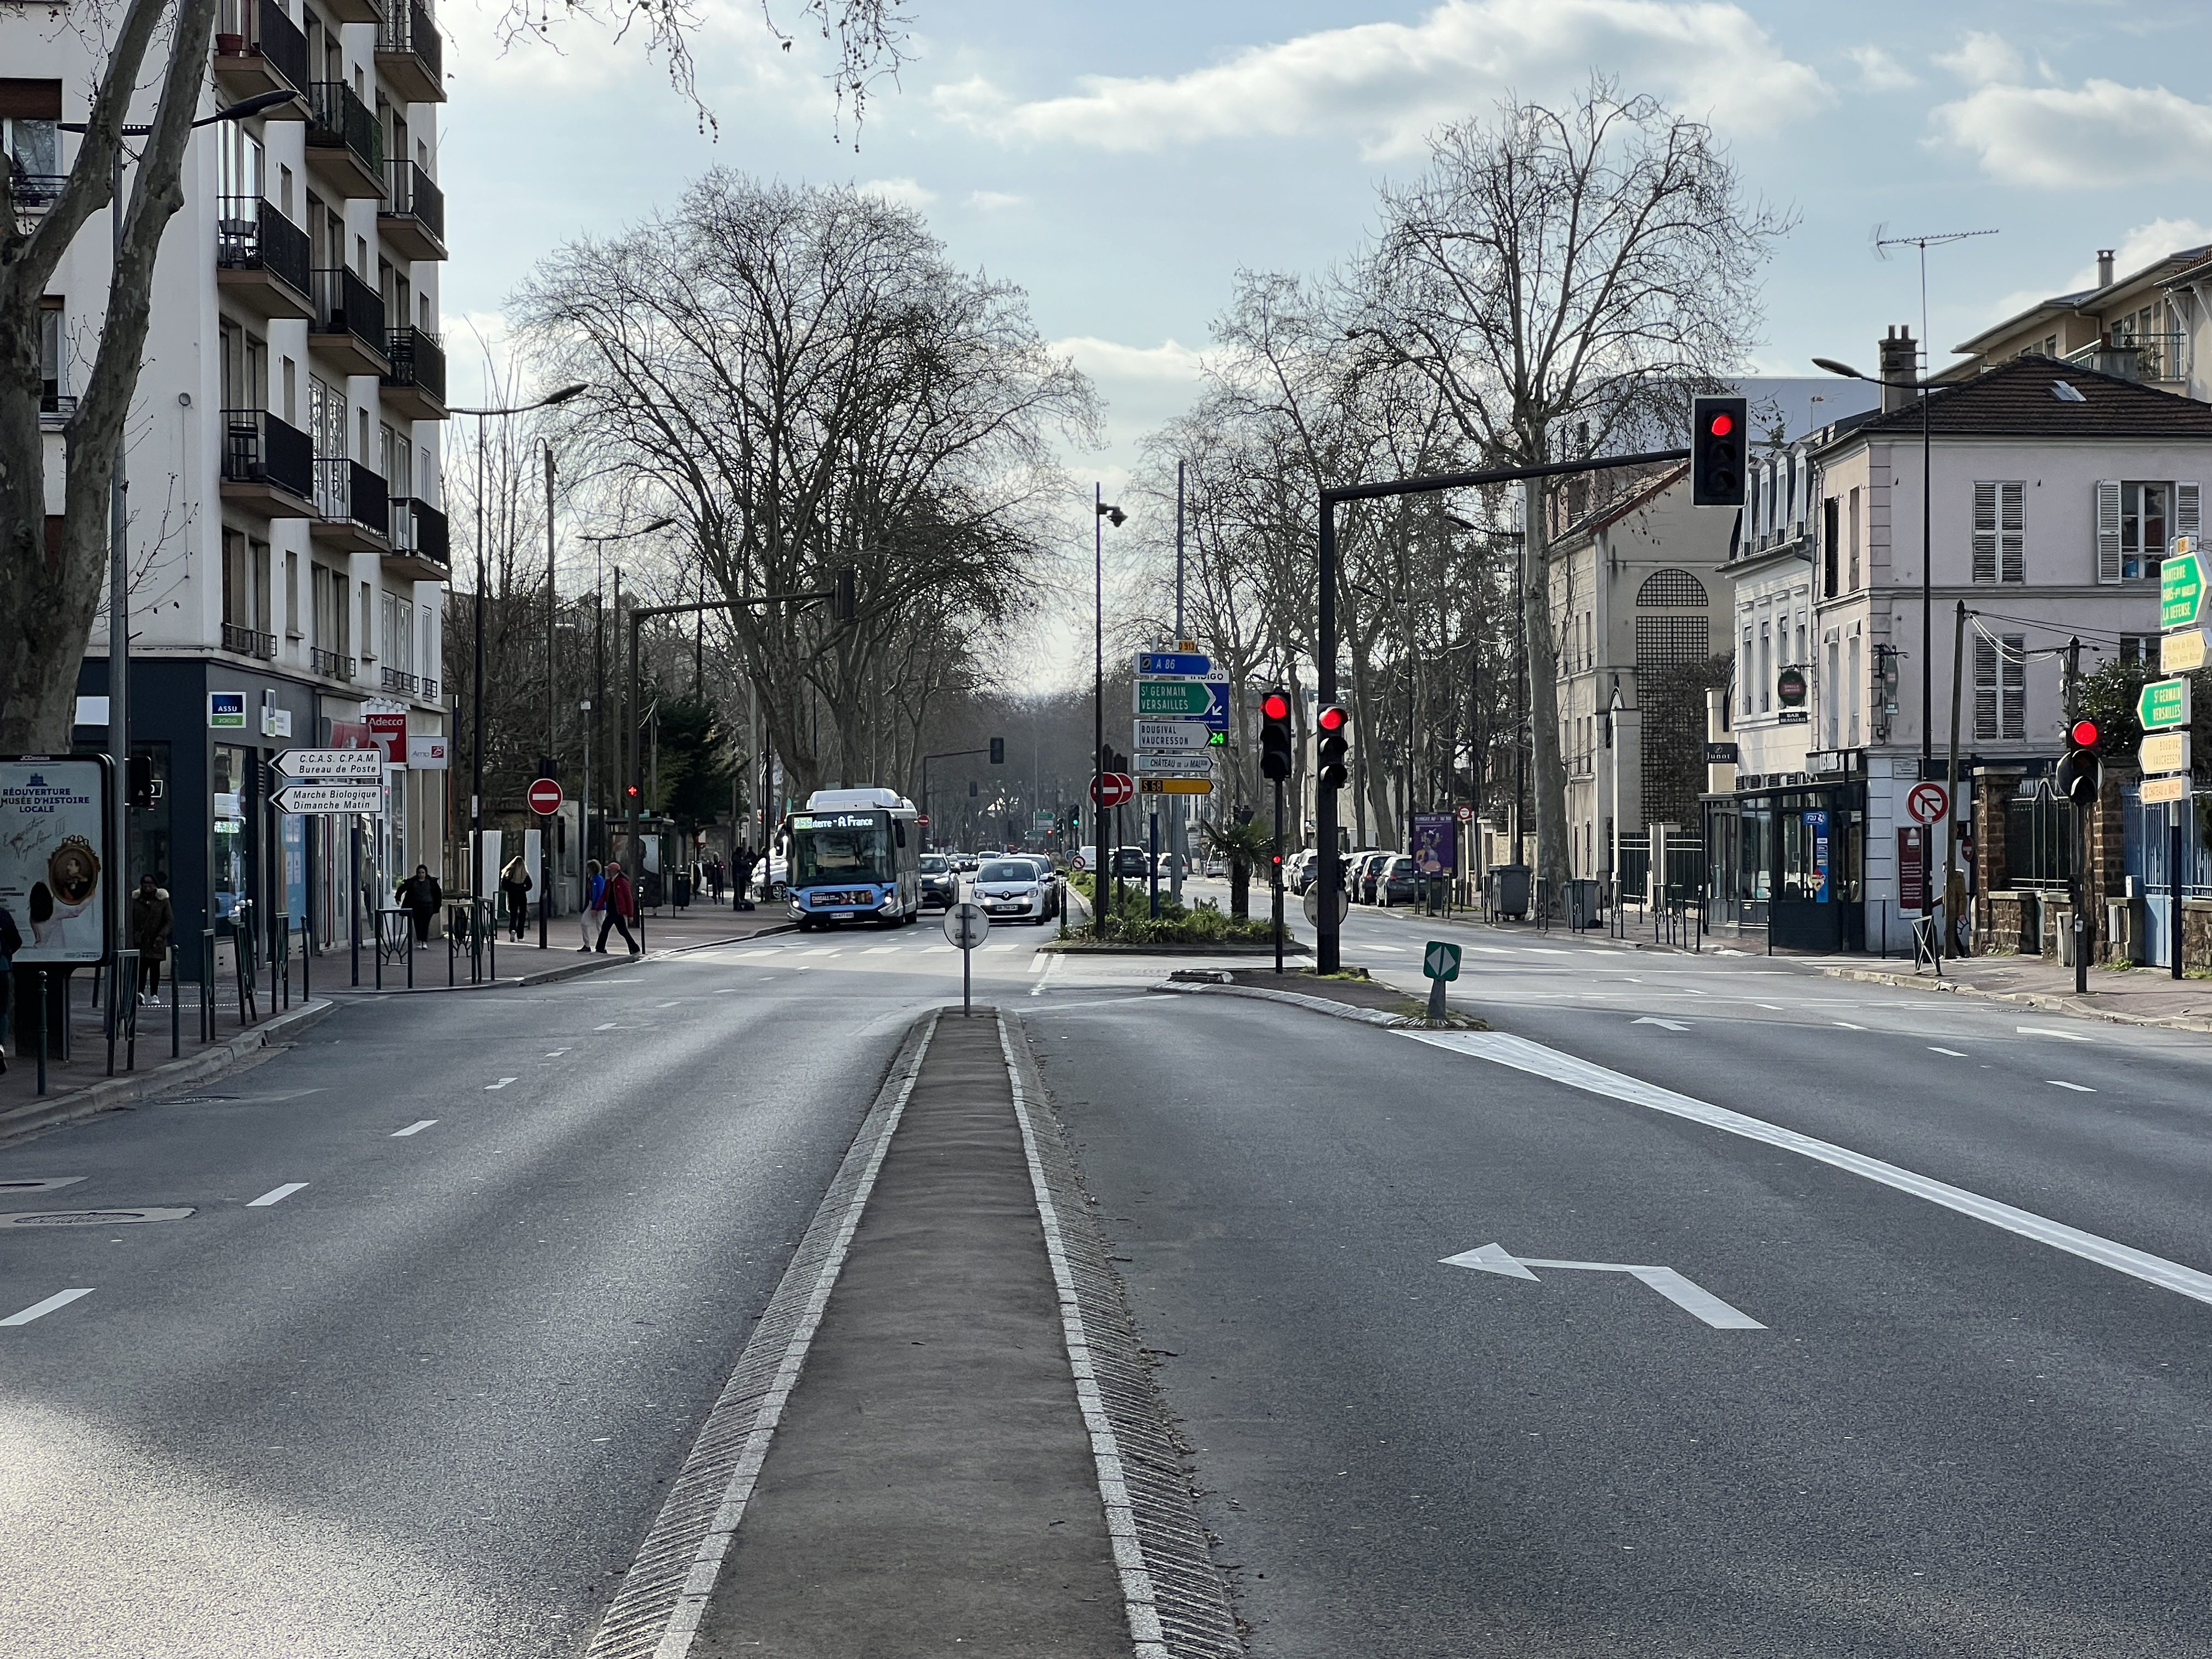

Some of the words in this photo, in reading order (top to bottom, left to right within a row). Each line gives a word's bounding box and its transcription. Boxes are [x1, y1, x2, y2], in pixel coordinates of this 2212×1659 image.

[2163, 607, 2169, 620] LA
[1156, 659, 1161, 669] A
[1165, 659, 1175, 669] 86
[1150, 686, 1186, 696] GERMAIN
[2159, 686, 2181, 702] GERMAIN
[1141, 699, 1188, 709] VERSAILLES
[2153, 704, 2181, 721] VERSAILLES
[369, 717, 404, 726] Adecco
[1141, 725, 1176, 734] BOUGIVAL
[1142, 736, 1188, 744] VAUCRESSON
[1211, 732, 1224, 744] 24
[300, 754, 335, 763] C.C.A.S.
[340, 754, 376, 763] C.P.A.M.
[1707, 752, 1730, 760] Junot
[1150, 758, 1175, 768] CHÂTEAU
[3, 787, 71, 795] RÉOUVERTURE
[1143, 781, 1148, 791] S
[1152, 781, 1161, 791] 68
[293, 791, 326, 799] Marché
[330, 790, 376, 800] Biologique
[0, 796, 32, 807] MUSÉE
[294, 801, 339, 809] Dimanche
[344, 800, 370, 809] Matin
[795, 818, 812, 828] 259
